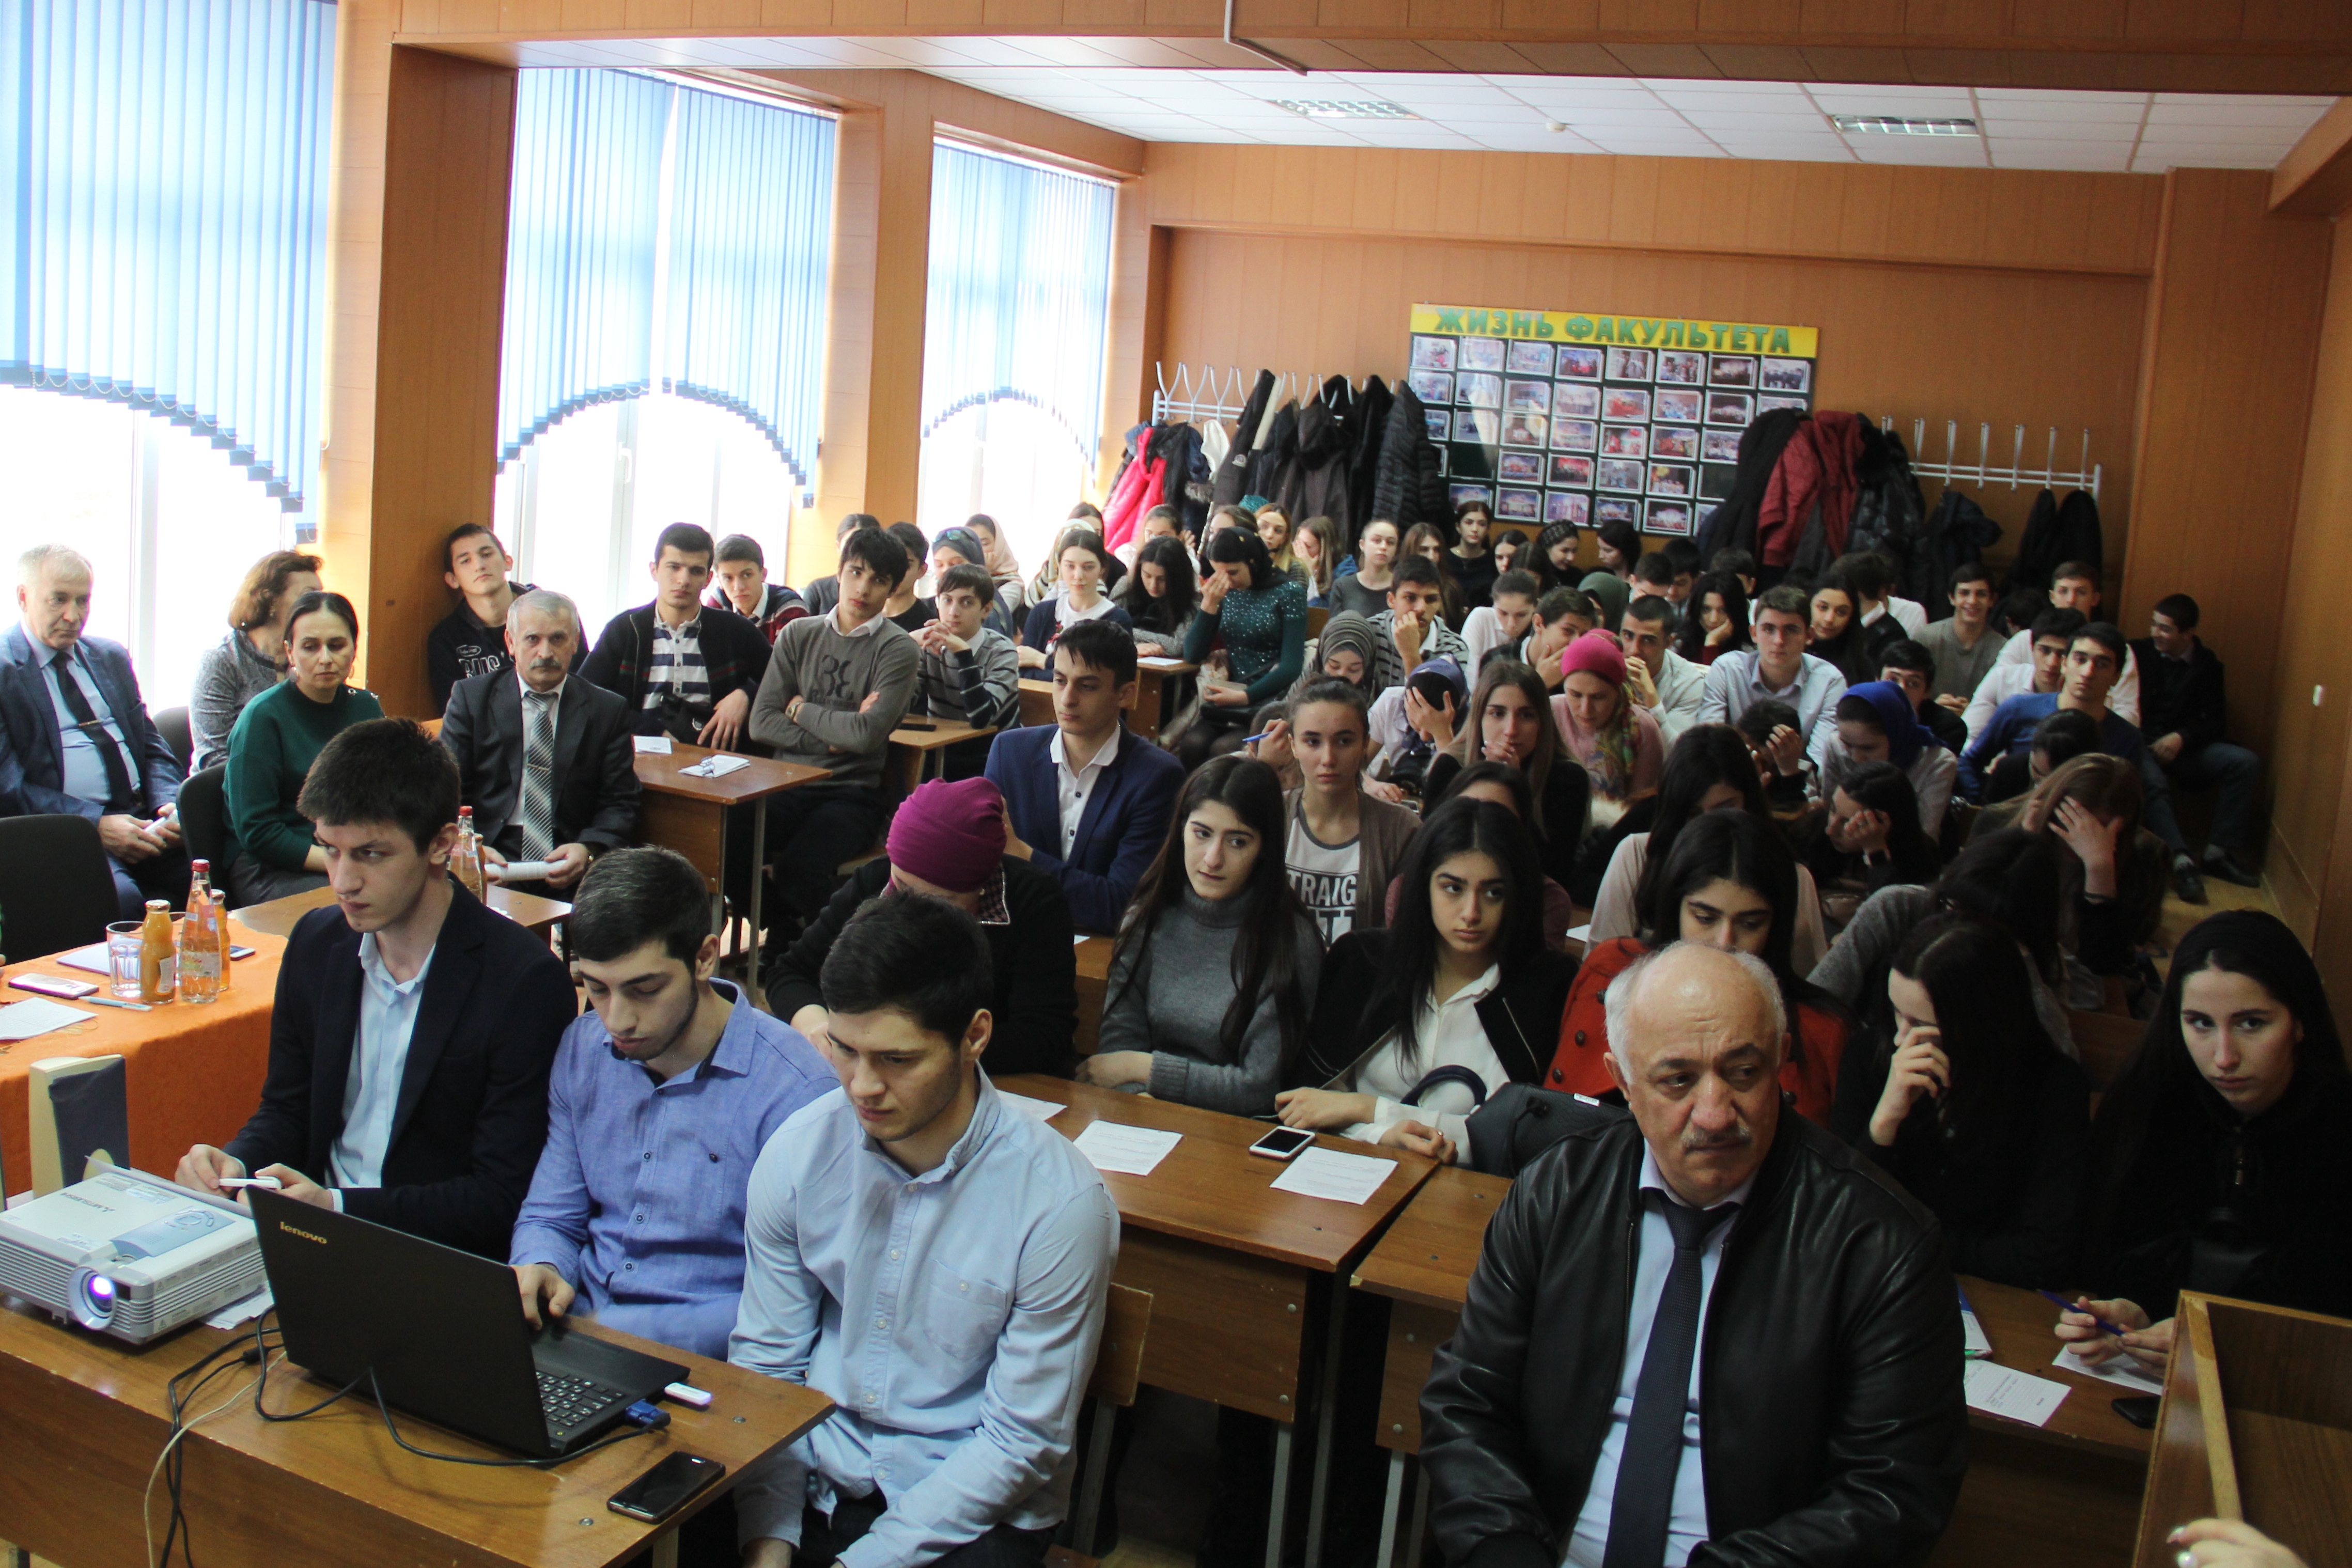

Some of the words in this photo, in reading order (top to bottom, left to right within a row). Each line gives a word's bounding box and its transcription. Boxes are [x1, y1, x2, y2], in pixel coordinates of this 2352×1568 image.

[1434, 307, 1553, 338] ЖИЗНЬ
[1566, 315, 1789, 354] ФАКУЛЬТЕТА
[1286, 869, 1357, 906] TRAIG
[280, 1221, 327, 1244] lenovo
